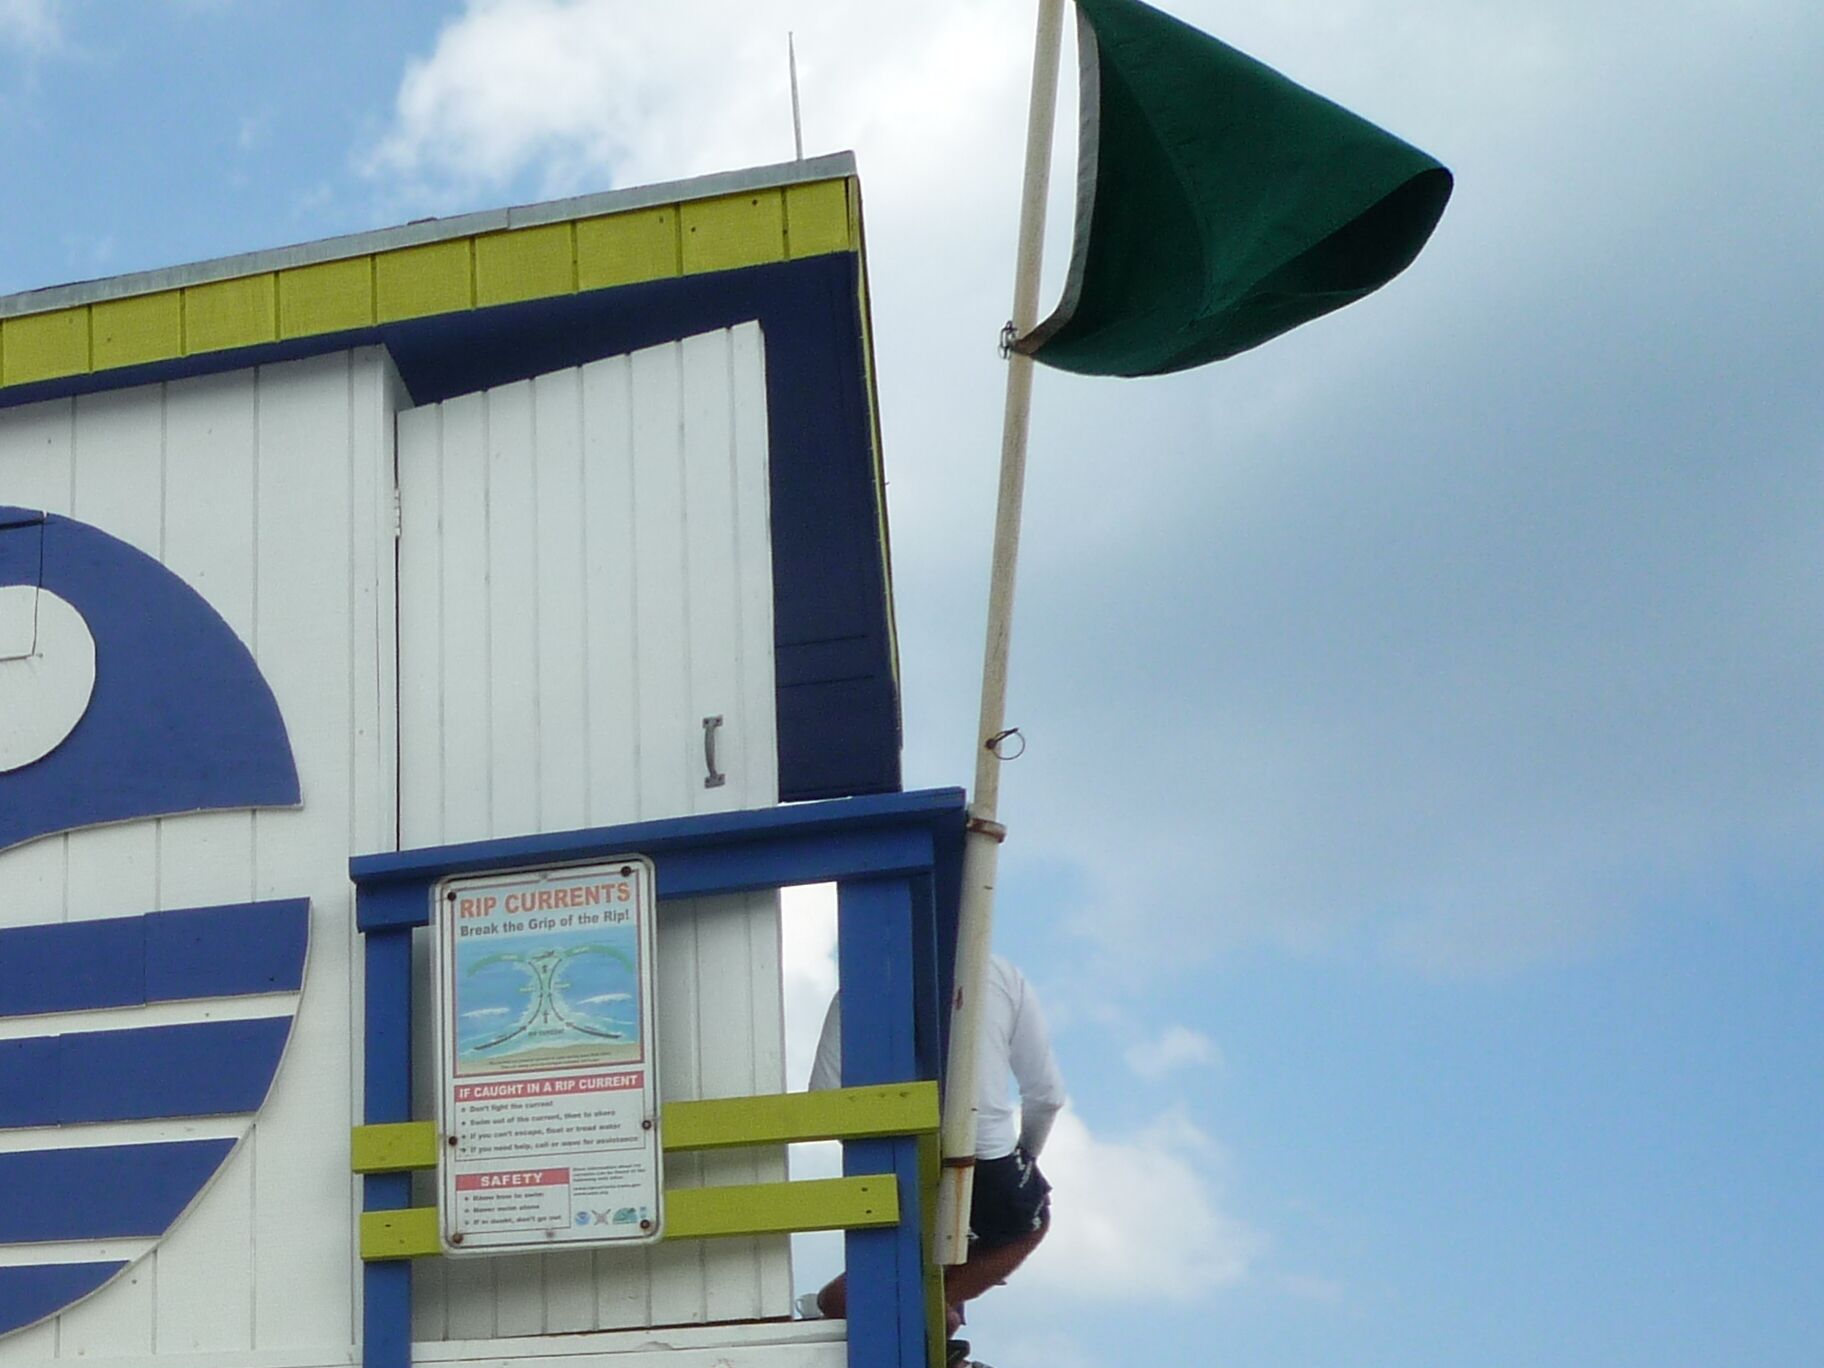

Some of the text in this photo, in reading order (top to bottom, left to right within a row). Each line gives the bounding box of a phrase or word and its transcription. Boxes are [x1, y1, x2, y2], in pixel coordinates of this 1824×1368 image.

[460, 883, 631, 918] RIP CURRENTS
[461, 909, 629, 937] Break the Grip of the Rip!
[460, 1075, 638, 1098] IF CAUGHT IN A RIP CURRENT
[481, 1172, 543, 1187] SAFETY
